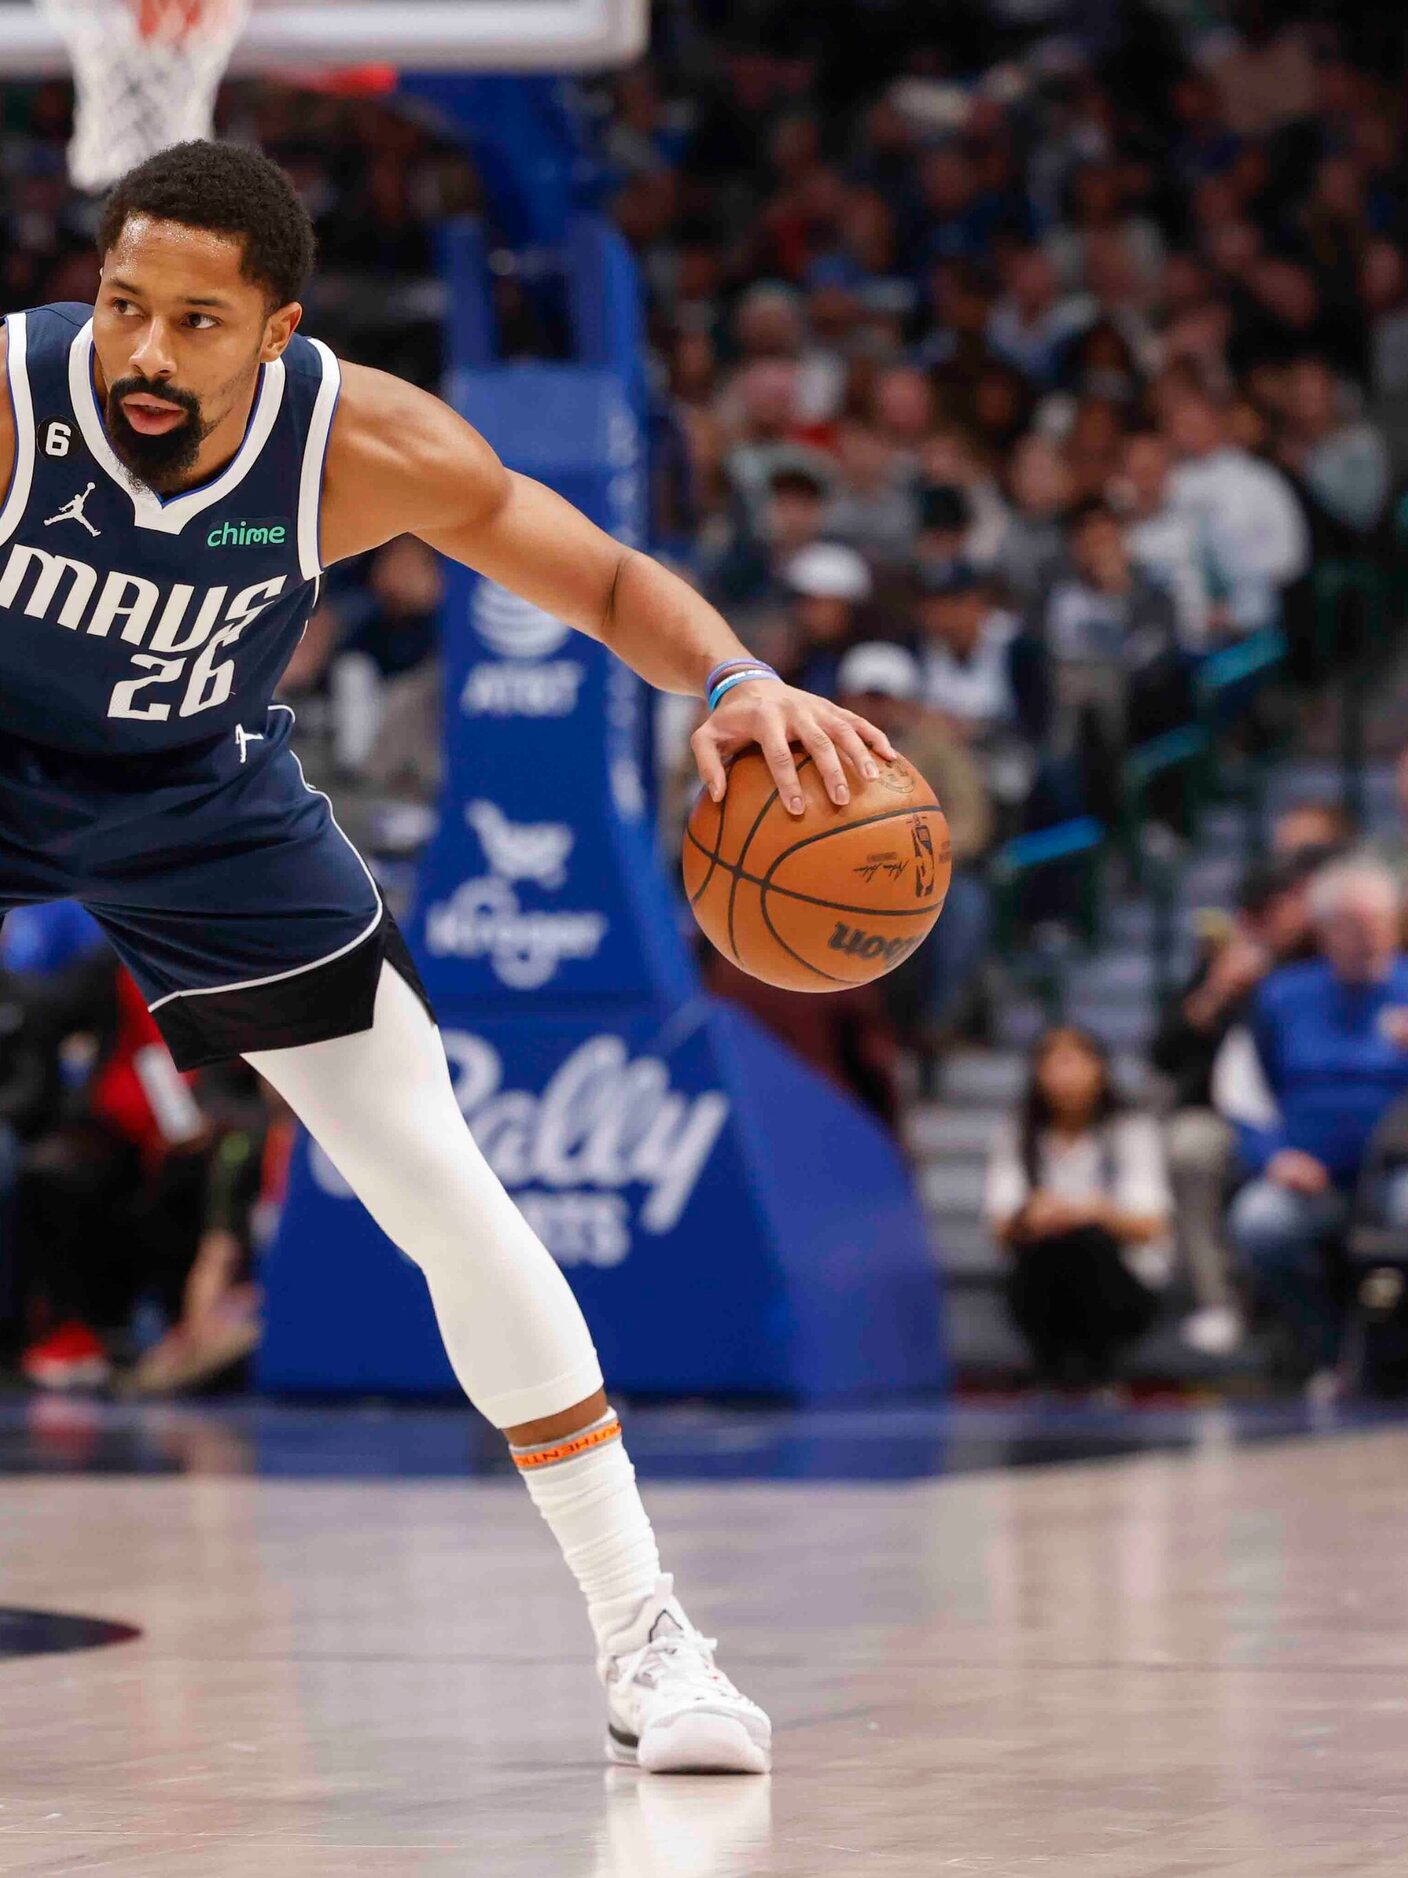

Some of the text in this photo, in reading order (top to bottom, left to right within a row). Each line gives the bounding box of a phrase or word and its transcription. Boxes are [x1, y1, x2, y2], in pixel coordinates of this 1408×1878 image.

[45, 421, 72, 457] 6
[206, 521, 286, 547] chime
[107, 634, 235, 721] 26
[426, 877, 606, 989] Kroger
